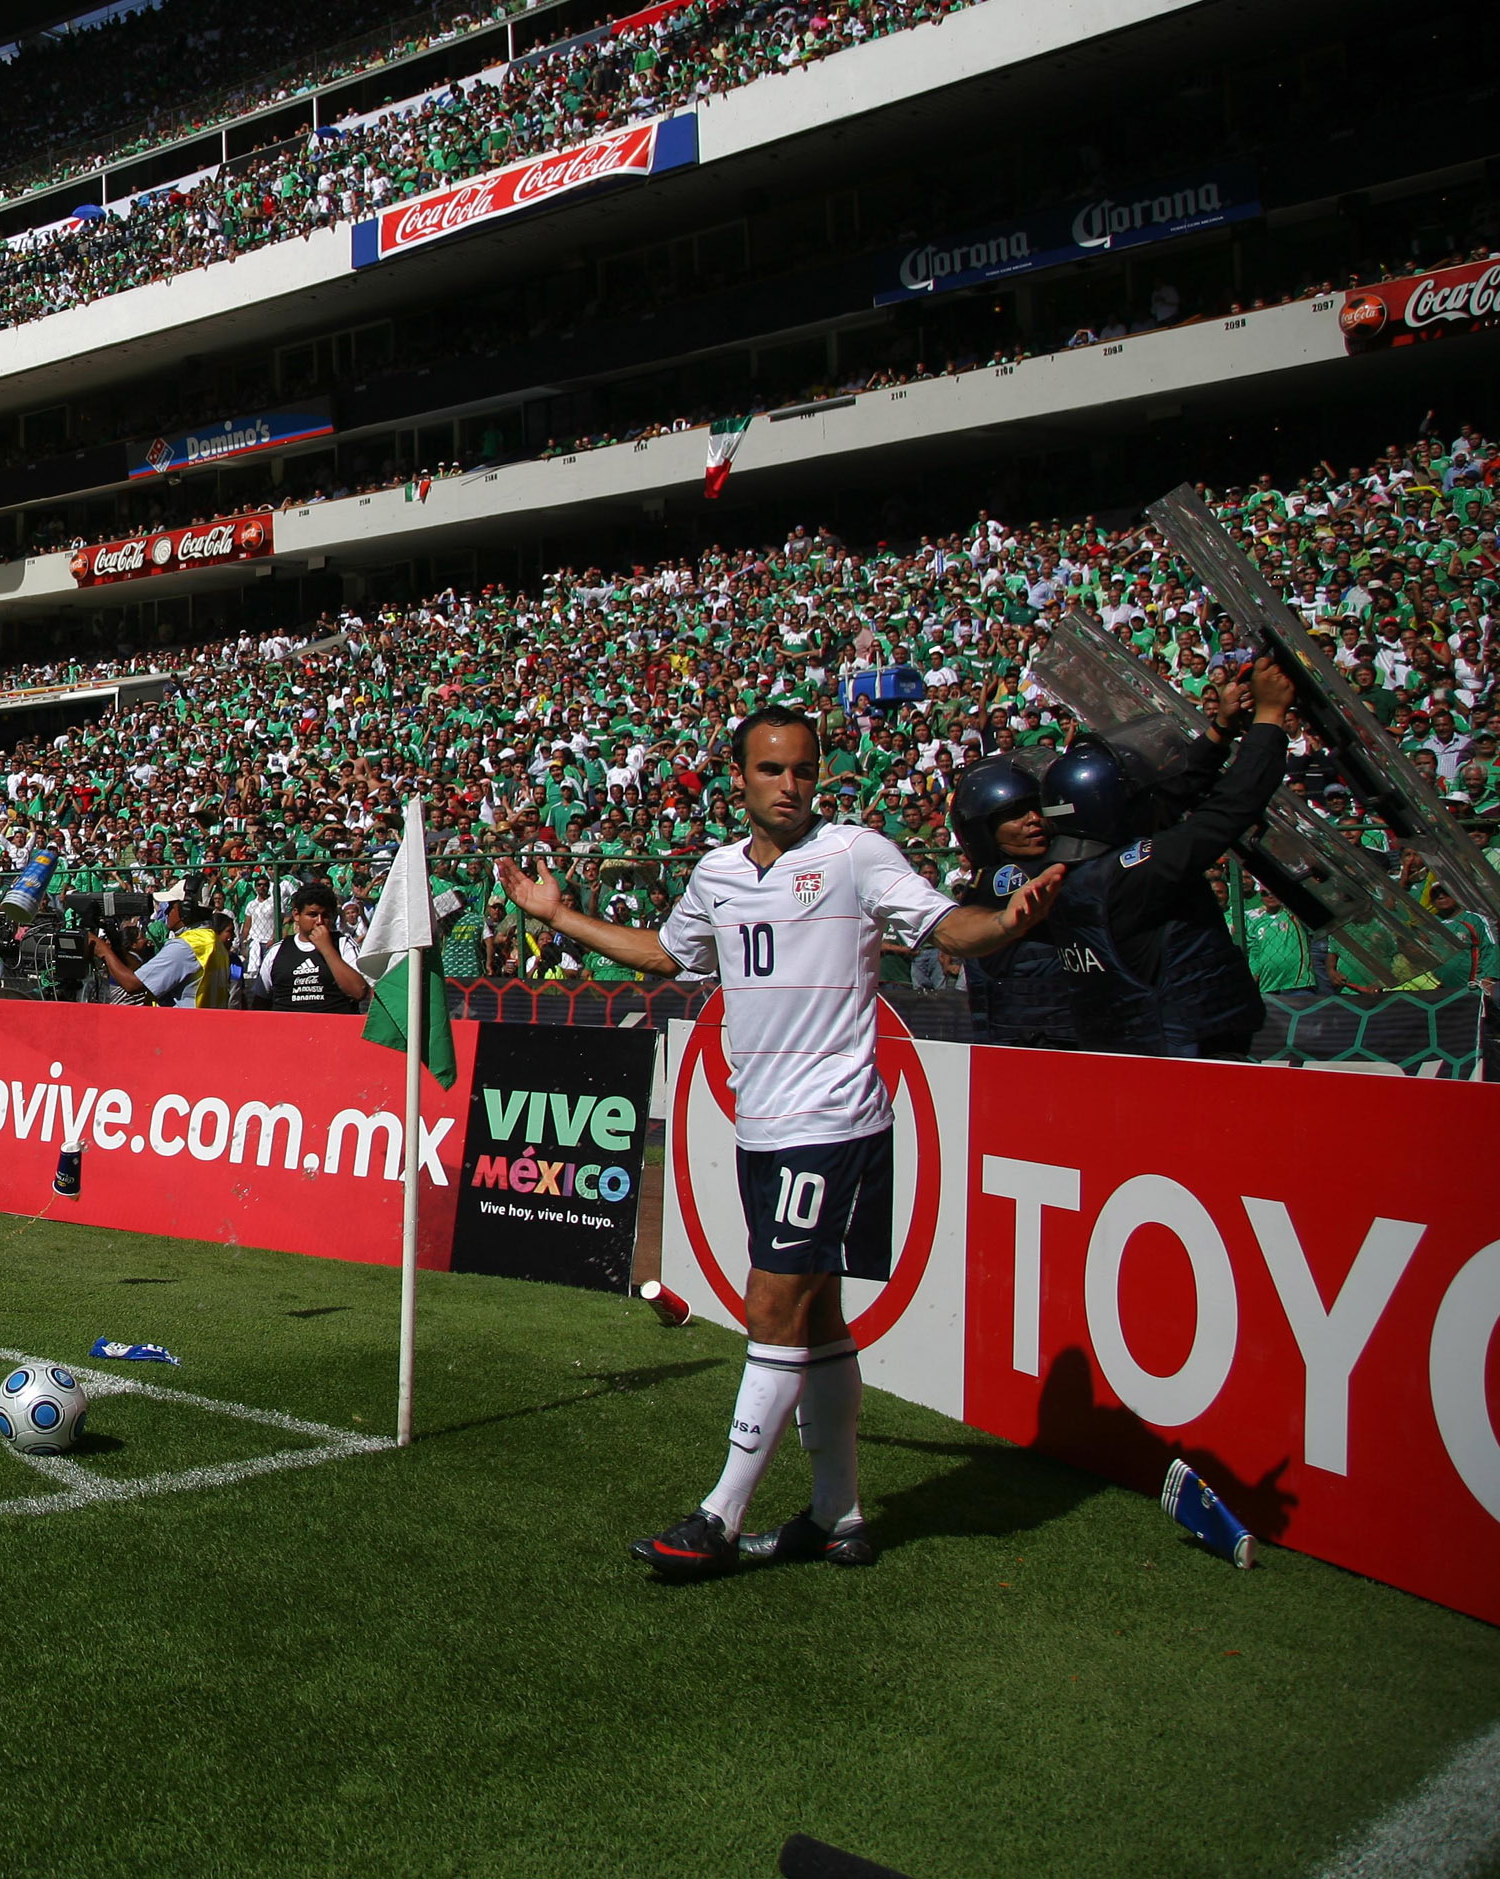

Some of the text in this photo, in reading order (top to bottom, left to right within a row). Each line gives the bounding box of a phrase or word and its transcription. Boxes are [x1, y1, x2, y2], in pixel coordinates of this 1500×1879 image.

[513, 133, 629, 203] Coca-Cola
[395, 176, 499, 245] Coca-Cola
[1071, 183, 1221, 249] Corona
[900, 231, 1032, 291] Corona
[1311, 300, 1335, 313] 2097
[1405, 264, 1500, 328] Coca-C
[1224, 318, 1247, 331] 2098
[186, 419, 270, 460] Domino's
[93, 540, 147, 576] Coca-Cola
[177, 523, 235, 561] Coca-Cola
[739, 923, 775, 978] 10
[291, 994, 325, 1002] Banamex
[480, 1200, 615, 1230] Vive hoy, vive lo tuyo.
[774, 1166, 826, 1230] 10
[732, 1418, 761, 1435] USA
